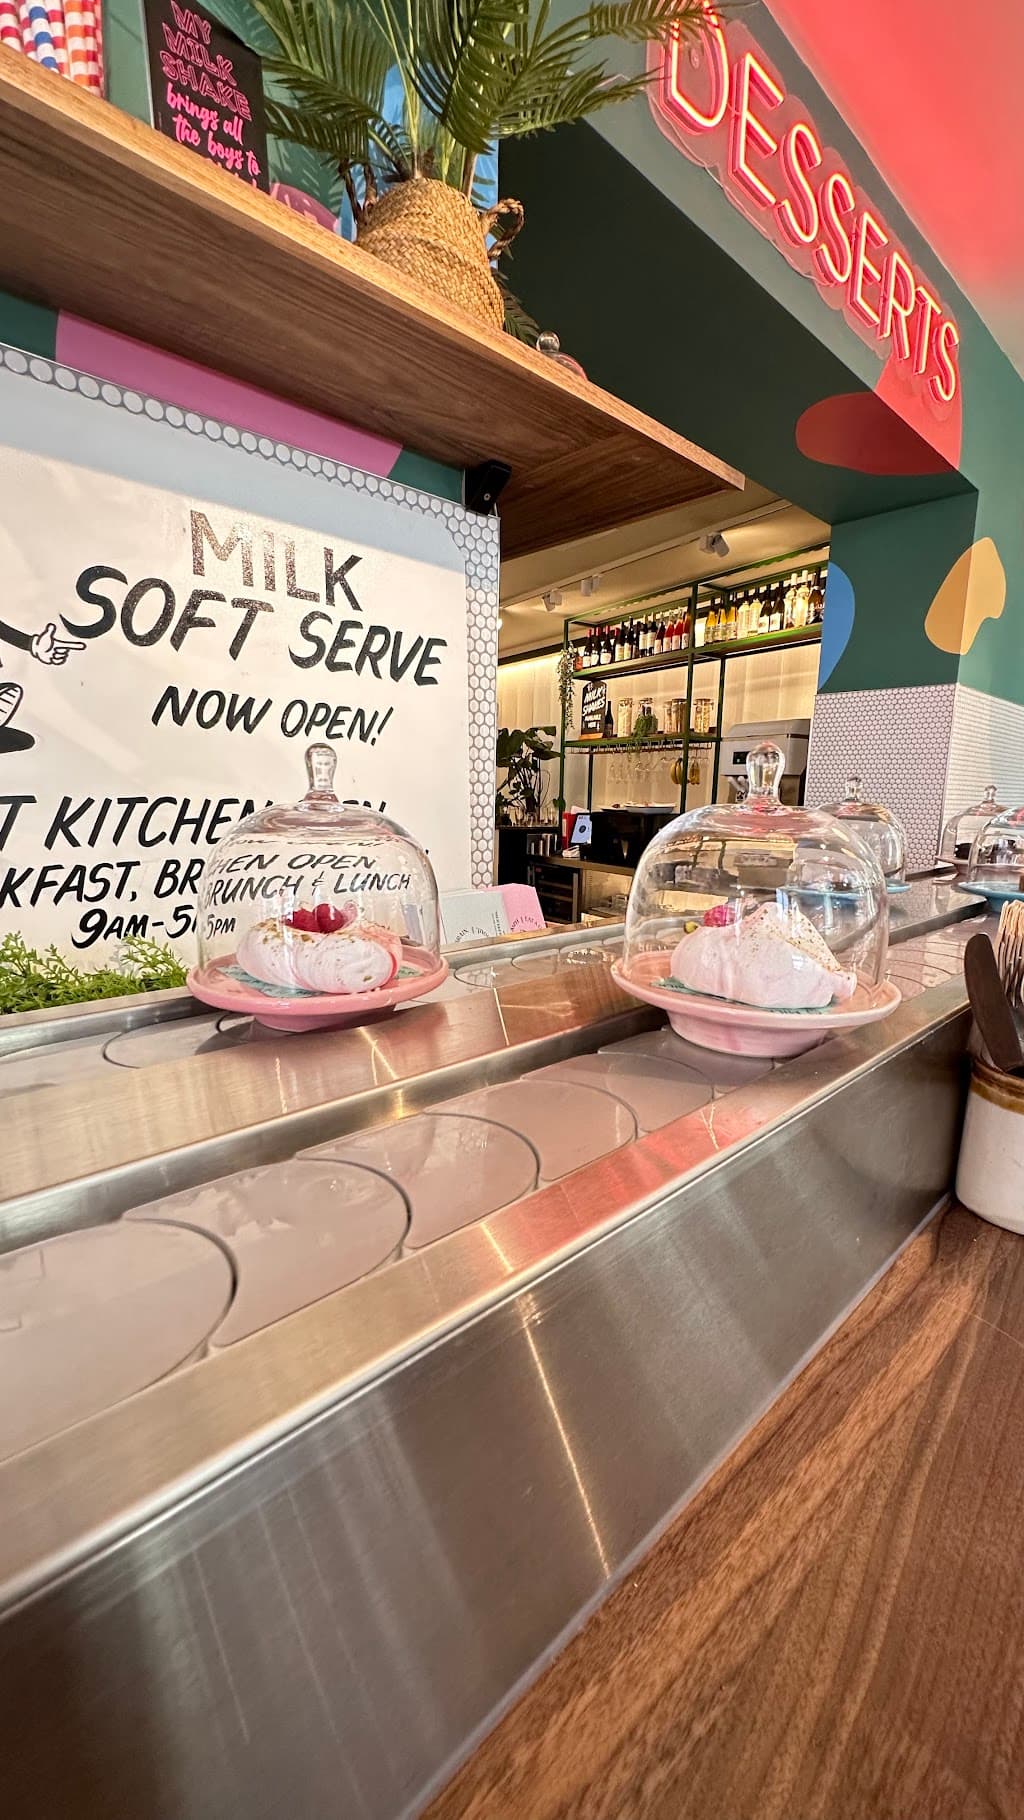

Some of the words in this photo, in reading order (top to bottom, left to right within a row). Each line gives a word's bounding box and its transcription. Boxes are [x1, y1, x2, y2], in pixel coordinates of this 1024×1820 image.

[162, 22, 237, 86] MILK
[170, 0, 211, 45] MY
[160, 50, 252, 122] SHAKE
[167, 82, 219, 130] brings
[223, 116, 243, 145] all
[172, 113, 200, 146] the
[208, 132, 244, 169] boys
[246, 150, 261, 175] to
[660, 0, 961, 402] DESSERTS
[190, 509, 363, 612] MILK
[59, 565, 274, 661] SOFT
[287, 611, 448, 686] SERVE
[151, 685, 272, 733] NOW
[280, 699, 394, 746] OPEN!
